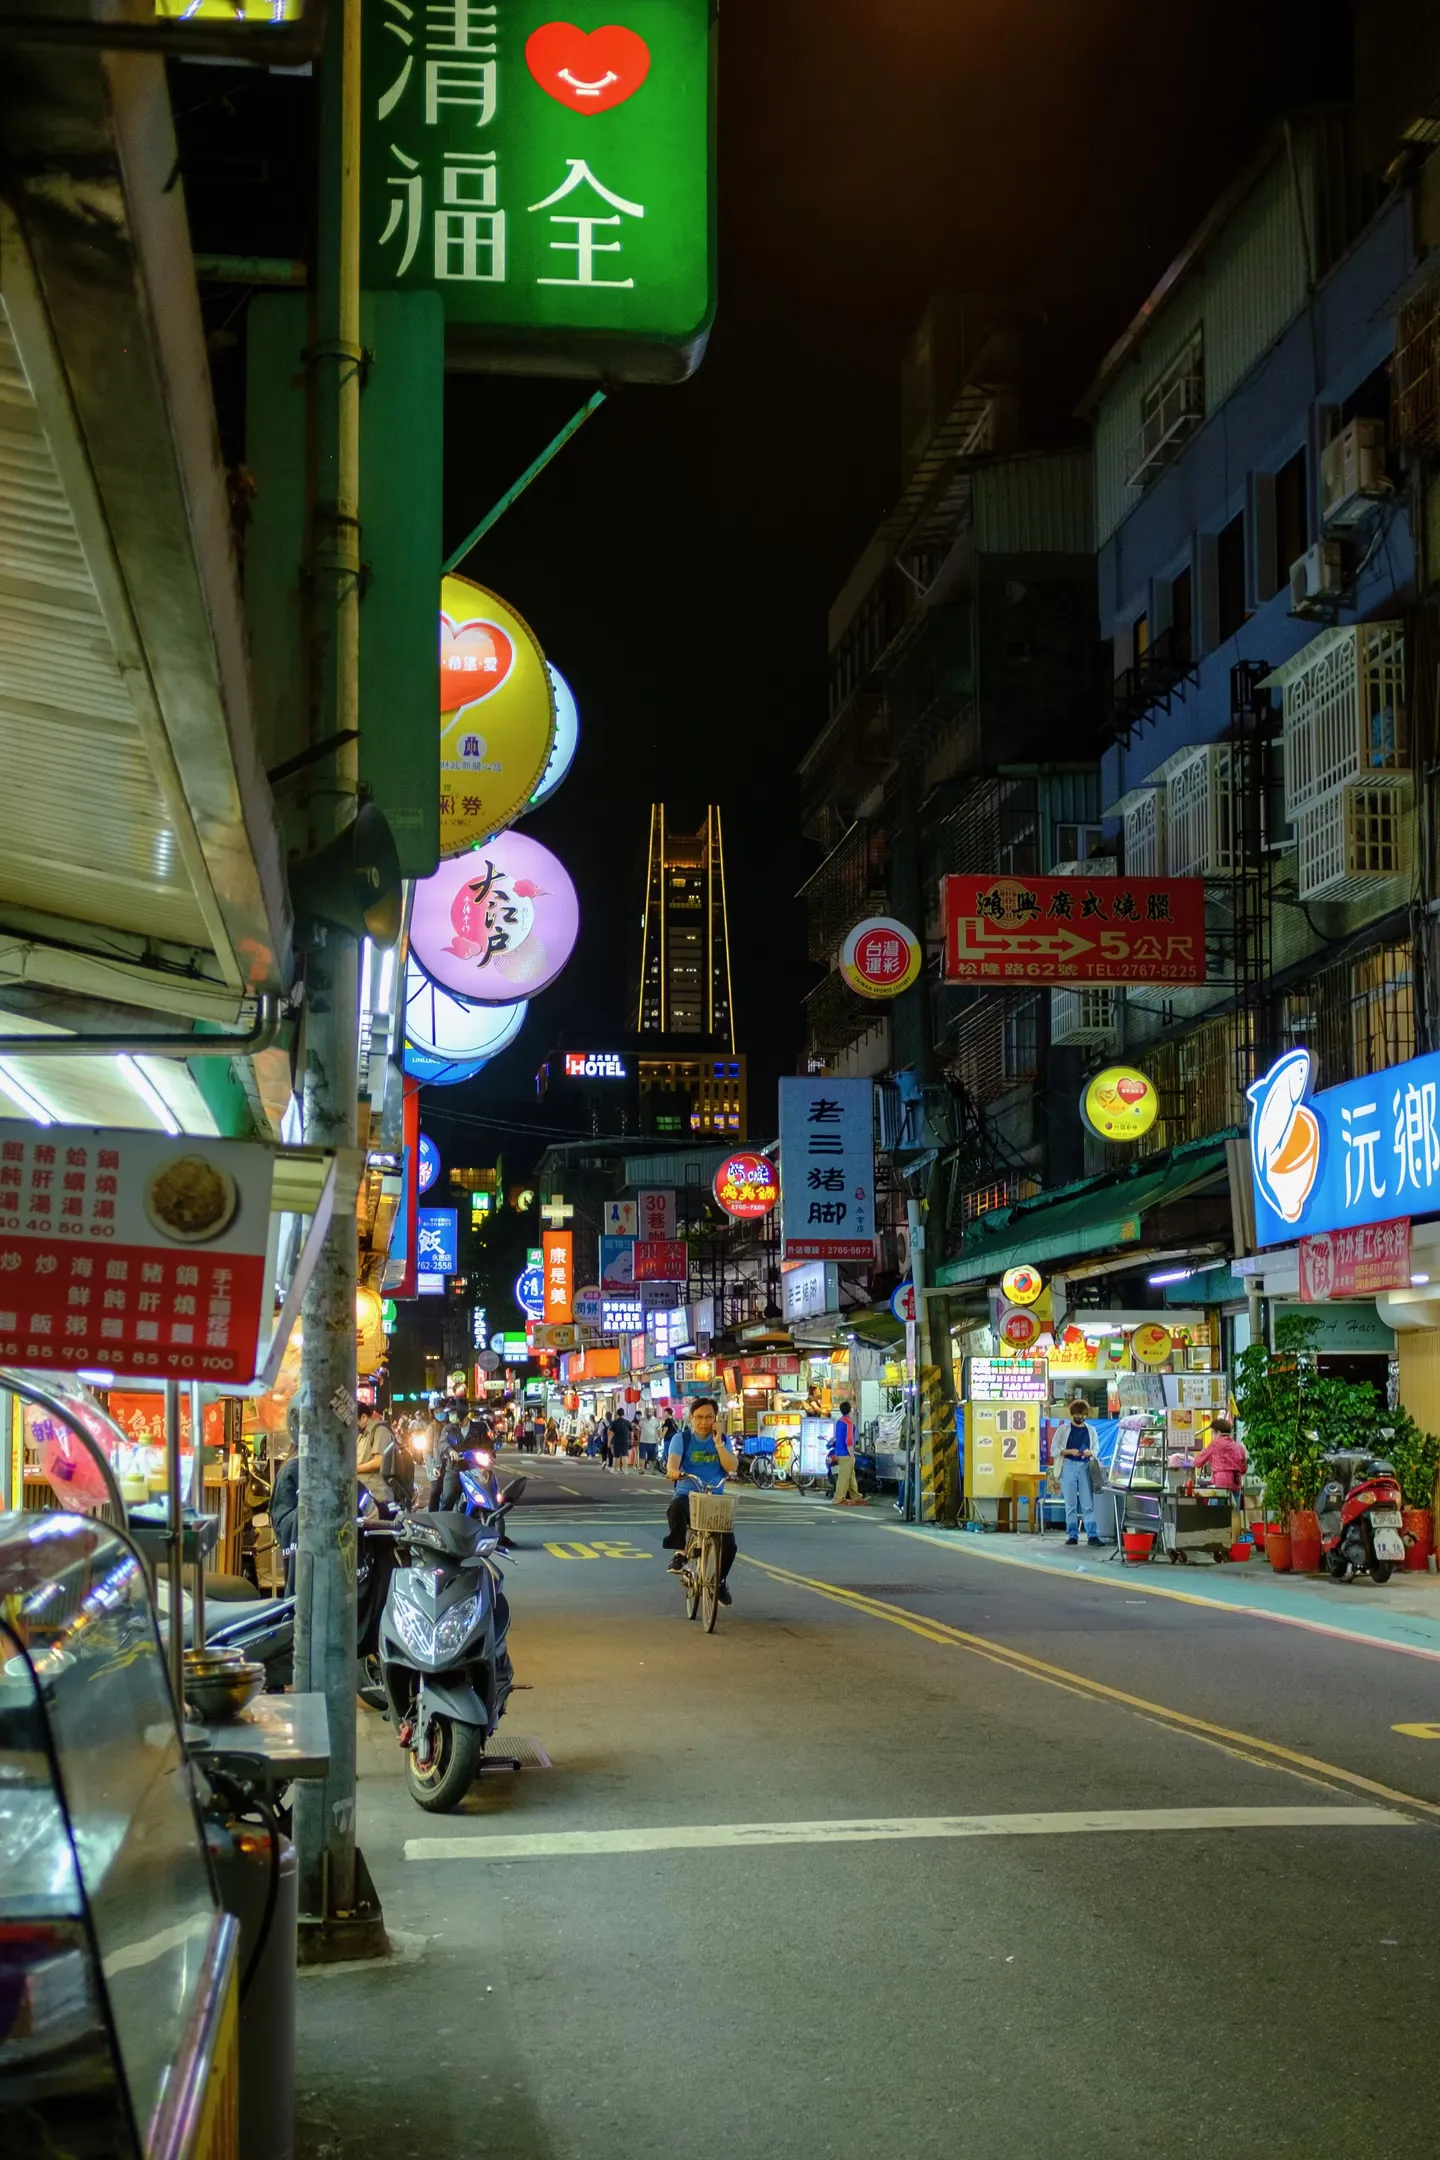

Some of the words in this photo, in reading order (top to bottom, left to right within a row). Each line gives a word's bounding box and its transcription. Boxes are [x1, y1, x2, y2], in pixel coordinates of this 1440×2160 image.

[469, 860, 519, 968] 大江戶
[866, 940, 899, 956] 台灣
[1100, 931, 1194, 961] 5公尺
[865, 957, 899, 973] 運彩
[958, 963, 1077, 976] 松隆路62號
[1086, 963, 1197, 977] TEL:2767-5225
[571, 1060, 625, 1076] HOTEL
[93, 1149, 119, 1220] 鍋燒湯
[26, 1219, 51, 1232] 40
[58, 1222, 83, 1235] 50
[90, 1225, 115, 1237] 60
[549, 1247, 567, 1306] 康是美
[66, 1257, 93, 1336] 海鮮粥
[171, 1266, 198, 1344] 鍋燒麵
[1345, 1319, 1376, 1332] Hair
[26, 1345, 52, 1357] 85
[62, 1347, 88, 1360] 90
[97, 1349, 123, 1362] 85
[132, 1351, 158, 1364] 85
[167, 1355, 193, 1368] 90
[202, 1356, 233, 1370] 100
[997, 1411, 1026, 1430] 18
[1003, 1438, 1016, 1458] 2
